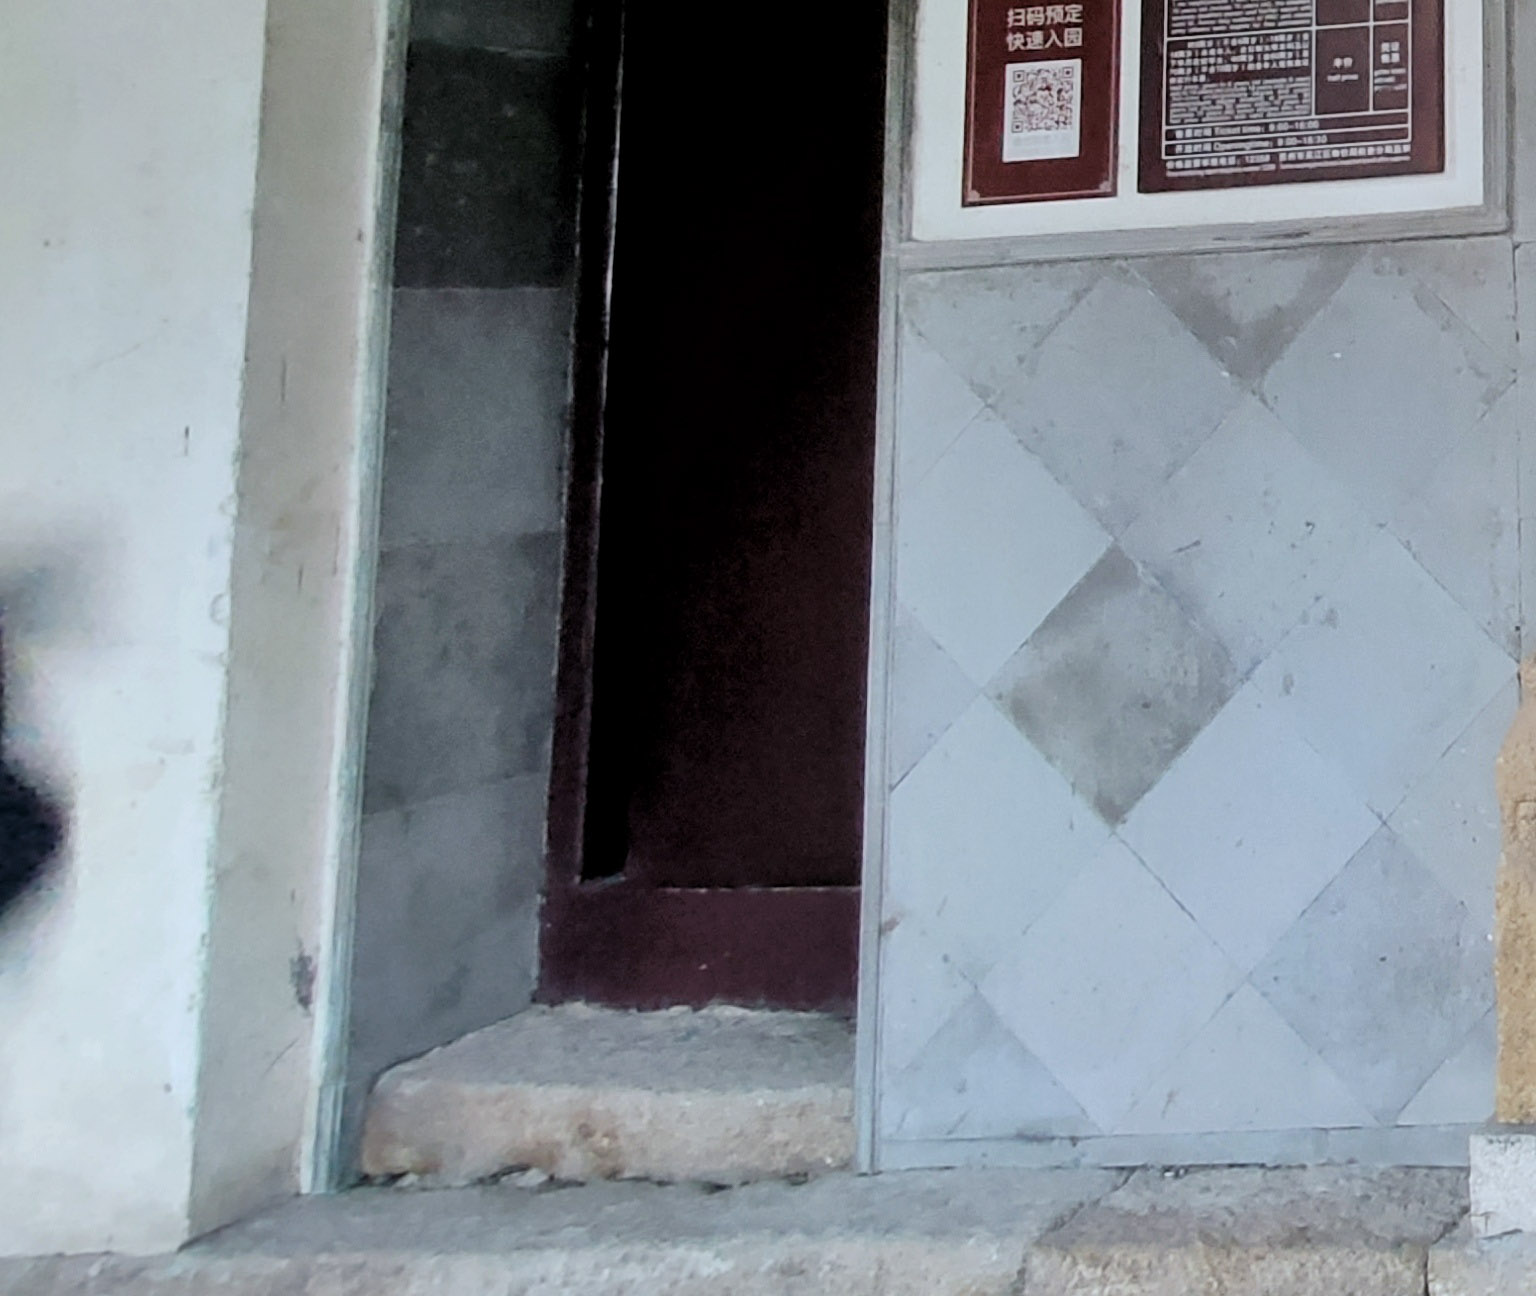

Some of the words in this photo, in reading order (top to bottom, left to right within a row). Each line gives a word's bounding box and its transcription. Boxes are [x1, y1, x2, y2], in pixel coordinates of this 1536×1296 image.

[1007, 4, 1084, 28] 扫码预定
[1006, 27, 1083, 52] 快速入园
